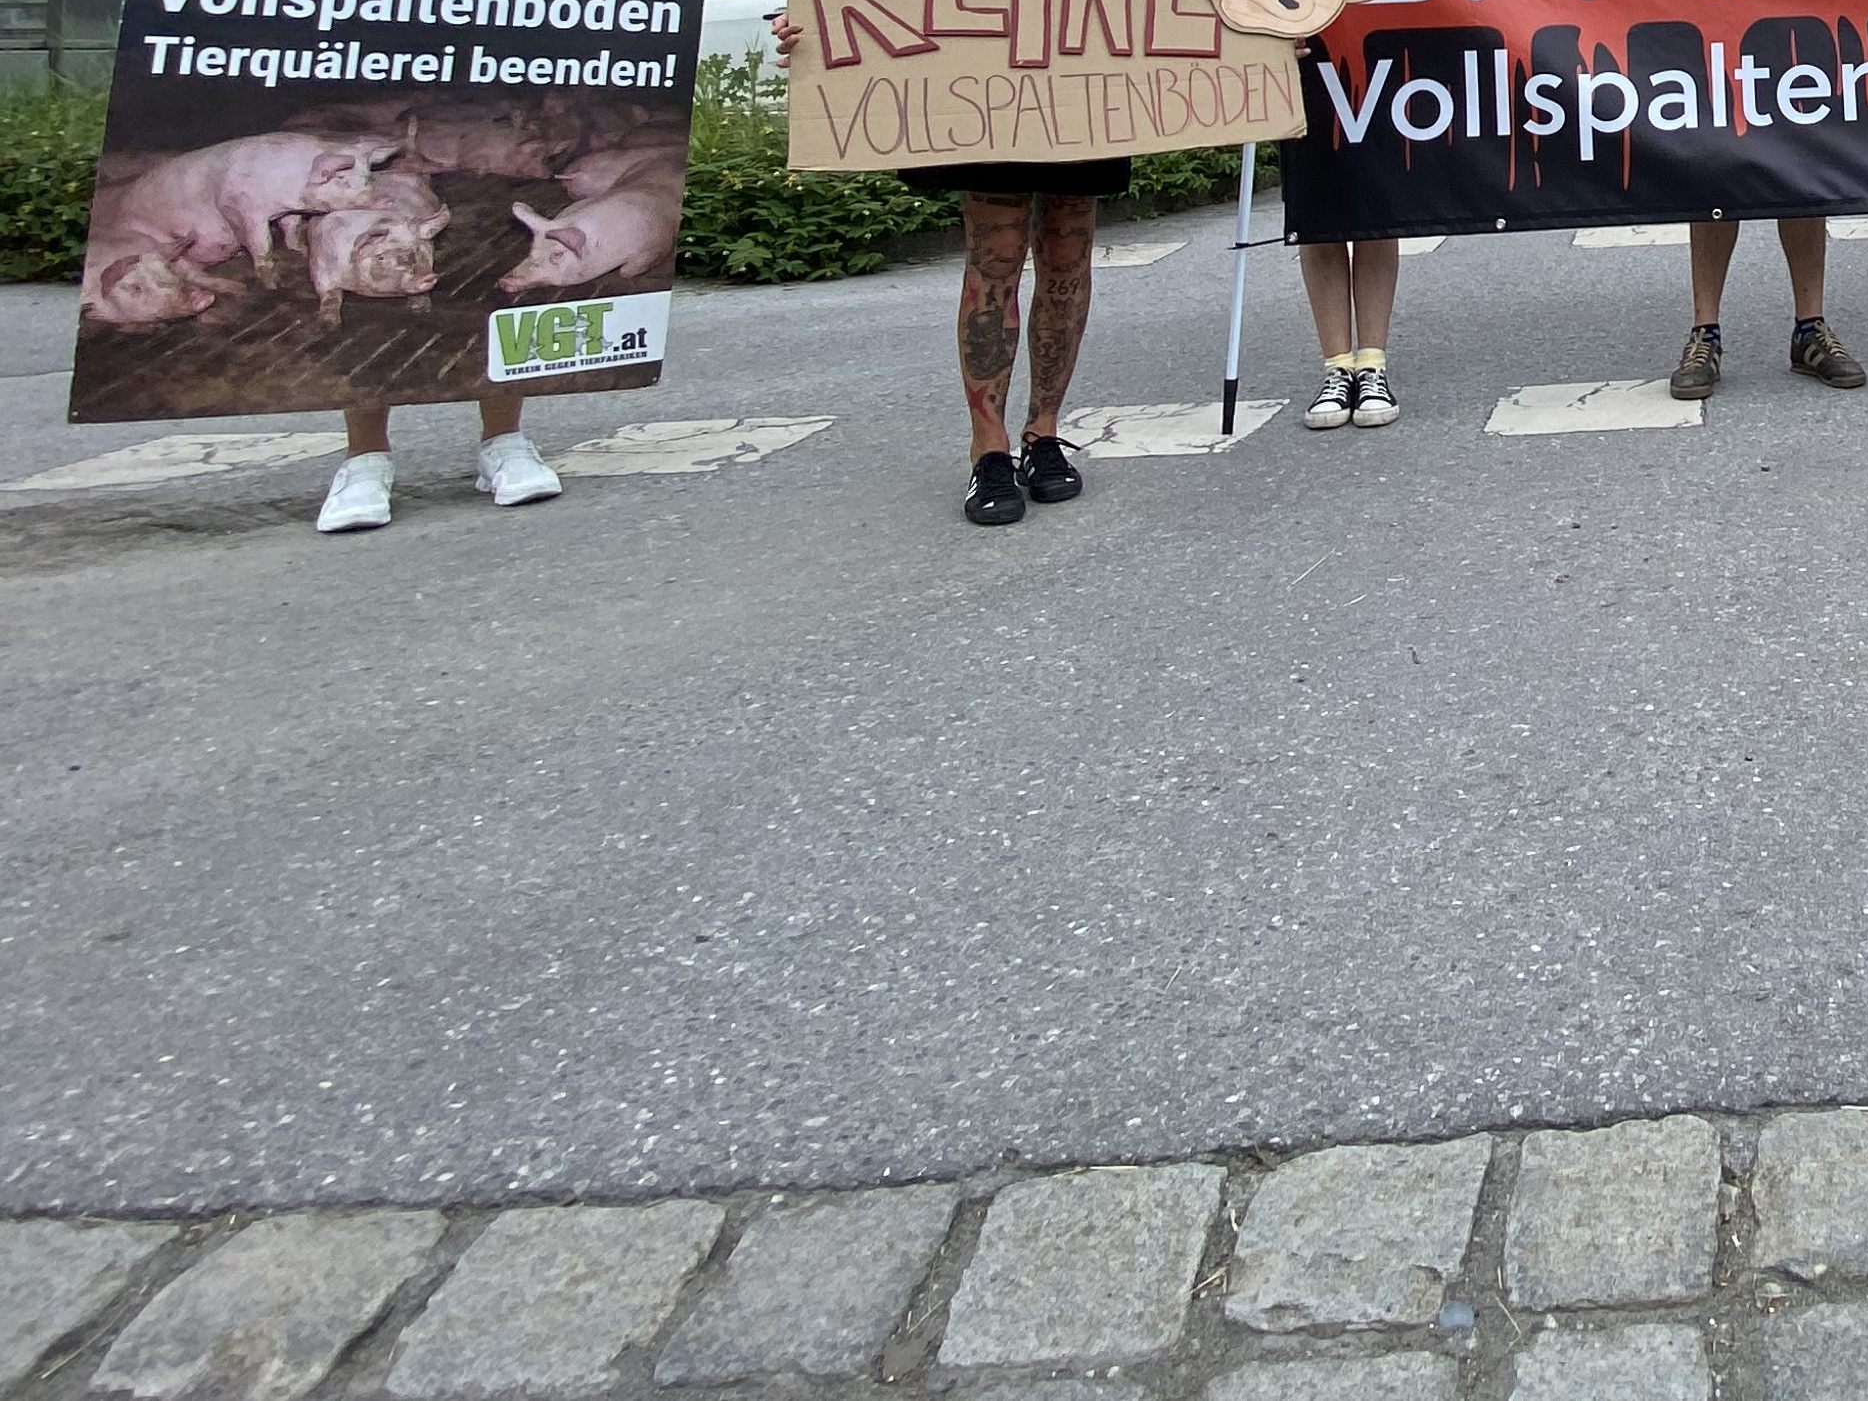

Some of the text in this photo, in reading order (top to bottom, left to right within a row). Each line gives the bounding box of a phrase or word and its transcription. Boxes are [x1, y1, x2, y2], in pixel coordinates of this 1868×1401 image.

[143, 35, 677, 88] Tierquälerei beenden!
[817, 60, 1297, 159] VOLLSPALTENBÖDEN
[1046, 278, 1080, 296] 269
[505, 365, 541, 375] VEREIN
[580, 351, 647, 366] TIERFABRIKEN
